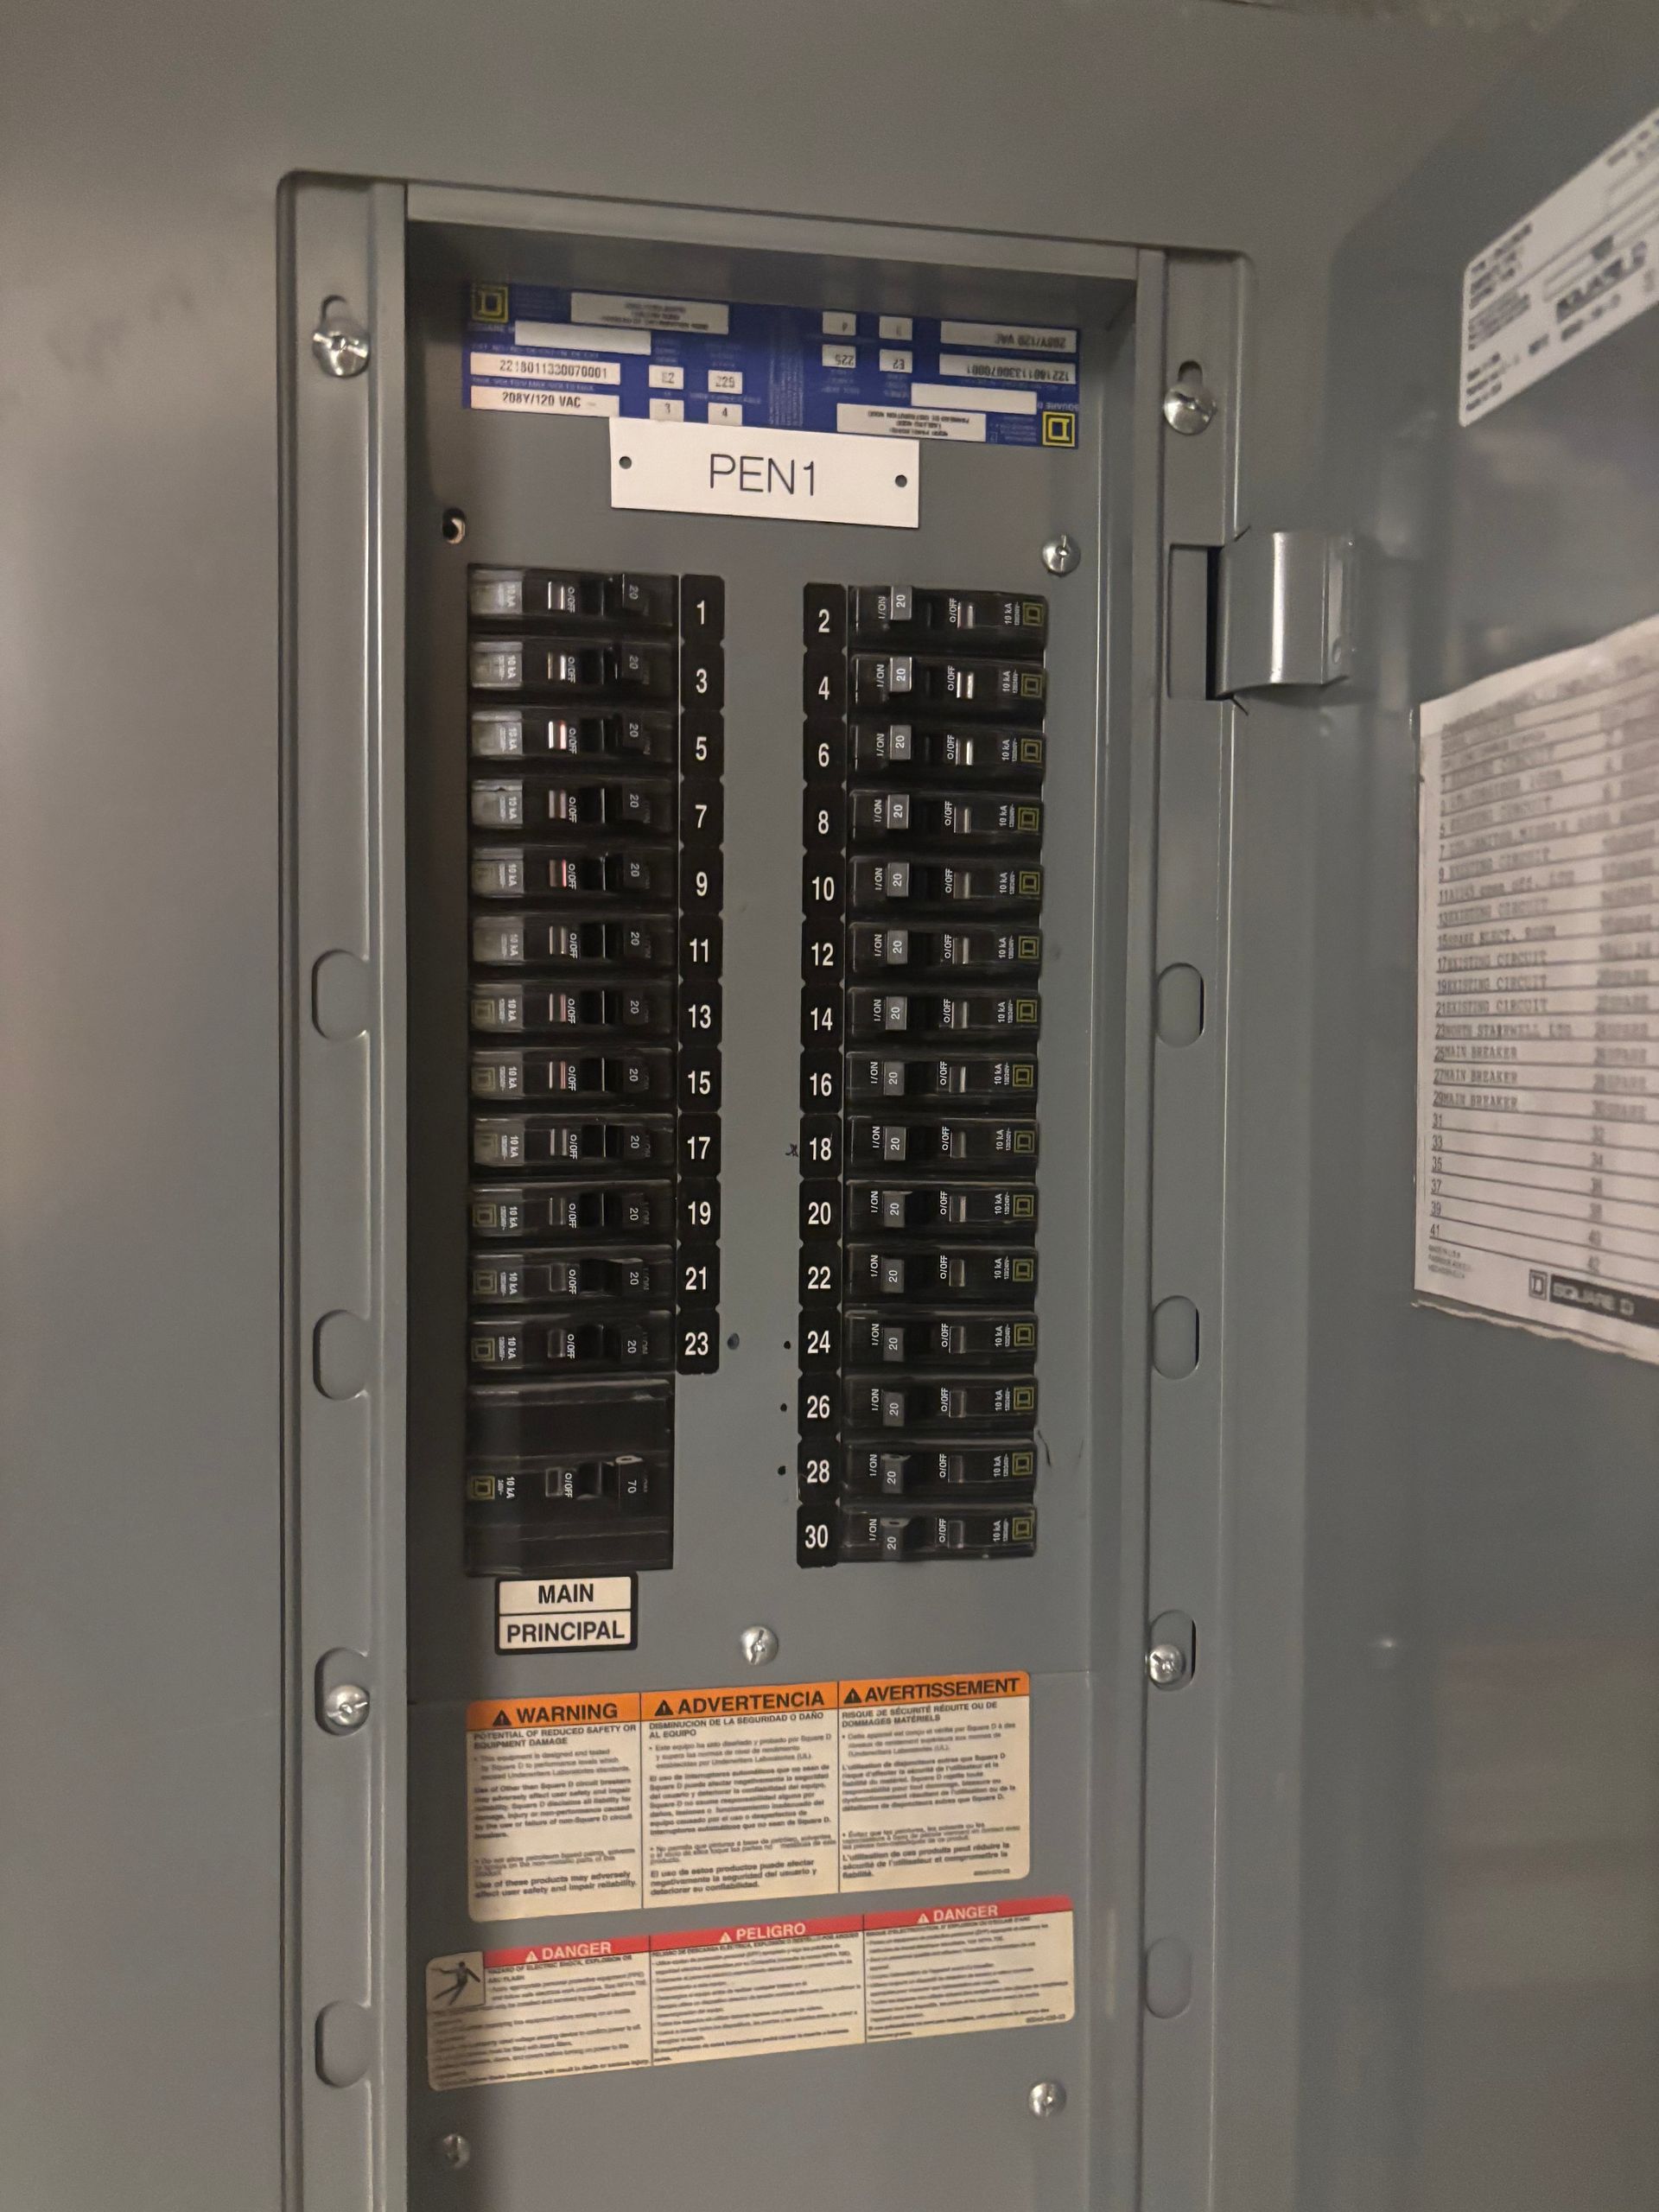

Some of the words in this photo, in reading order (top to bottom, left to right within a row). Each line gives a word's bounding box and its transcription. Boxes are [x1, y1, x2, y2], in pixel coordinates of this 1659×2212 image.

[502, 391, 555, 407] 208Y/120
[559, 397, 581, 409] VAC
[710, 454, 815, 496] PEN1
[897, 594, 906, 607] 20
[696, 601, 705, 625] 1
[817, 608, 830, 633] 2
[696, 669, 707, 693] 3
[897, 669, 906, 682] 20
[818, 676, 830, 700] 4
[696, 736, 707, 760] 5
[896, 735, 905, 748] 20
[817, 743, 830, 767] 6
[695, 805, 707, 828] 7
[893, 804, 902, 818] 20
[817, 810, 830, 835] 8
[631, 862, 639, 877] 20
[696, 872, 708, 897] 9
[812, 876, 835, 901] 10
[893, 874, 902, 887] 20
[631, 931, 639, 945] 20
[690, 938, 709, 963] 11
[811, 942, 834, 966] 12
[893, 941, 902, 954] 20
[631, 1001, 639, 1014] 20
[892, 1007, 900, 1020] 20
[688, 1005, 711, 1028] 13
[810, 1007, 833, 1031] 14
[1471, 1046, 1517, 1060] BREAKER
[629, 1068, 638, 1082] 20
[688, 1071, 710, 1094] 15
[889, 1072, 898, 1085] 20
[1471, 1071, 1517, 1084] BREAKER
[809, 1072, 831, 1096] 16
[1471, 1096, 1517, 1111] BREAKER
[1433, 1113, 1443, 1127] 31
[631, 1135, 639, 1149] 20
[688, 1137, 710, 1160] 17
[809, 1137, 831, 1161] 18
[892, 1137, 899, 1151] 20
[1433, 1135, 1443, 1149] 33
[1433, 1156, 1442, 1172] 35
[1431, 1179, 1441, 1192] 37
[630, 1207, 639, 1221] 20
[688, 1203, 711, 1225] 19
[809, 1202, 831, 1225] 20
[890, 1203, 899, 1216] 20
[1431, 1201, 1441, 1216] 39
[1430, 1224, 1440, 1237] 41
[631, 1272, 639, 1286] 20
[685, 1268, 707, 1289] 21
[807, 1267, 831, 1289] 22
[889, 1270, 898, 1282] 20
[1552, 1282, 1615, 1311] SQUARE
[684, 1332, 709, 1355] 23
[807, 1331, 830, 1353] 24
[889, 1338, 898, 1350] 20
[807, 1395, 830, 1419] 26
[890, 1403, 899, 1416] 20
[807, 1459, 830, 1483] 28
[888, 1471, 896, 1484] 20
[627, 1480, 637, 1493] 70
[805, 1524, 828, 1548] 30
[887, 1536, 896, 1550] 20
[538, 1584, 594, 1604] MAIN
[506, 1621, 626, 1643] PRINCIPAL
[865, 1678, 1020, 1702] AVERTISSEMENT
[678, 1691, 824, 1714] ADVERTENCIA
[842, 1710, 874, 1719] RISQUE
[876, 1708, 887, 1717] DE
[890, 1705, 931, 1715] SÉCURITÉ
[934, 1703, 969, 1713] RÉDUITE
[517, 1703, 617, 1724] WARNING
[737, 1714, 787, 1724] SEGURIDAD
[799, 1711, 824, 1719] DAÑO
[842, 1717, 892, 1727] DOMMAGES
[894, 1713, 940, 1724] MATÉRIELS
[474, 1729, 524, 1739] POTENTIAL
[542, 1727, 584, 1736] REDUCED
[587, 1726, 620, 1734] SAFETY
[650, 1730, 661, 1738] AL
[663, 1728, 696, 1738] EQUIPO
[474, 1739, 525, 1750] EQUIPMENT
[529, 1738, 568, 1746] DAMAGE
[933, 1904, 998, 1922] DANGER
[736, 1923, 806, 1941] PELIGRO
[542, 1942, 611, 1960] DANGER
